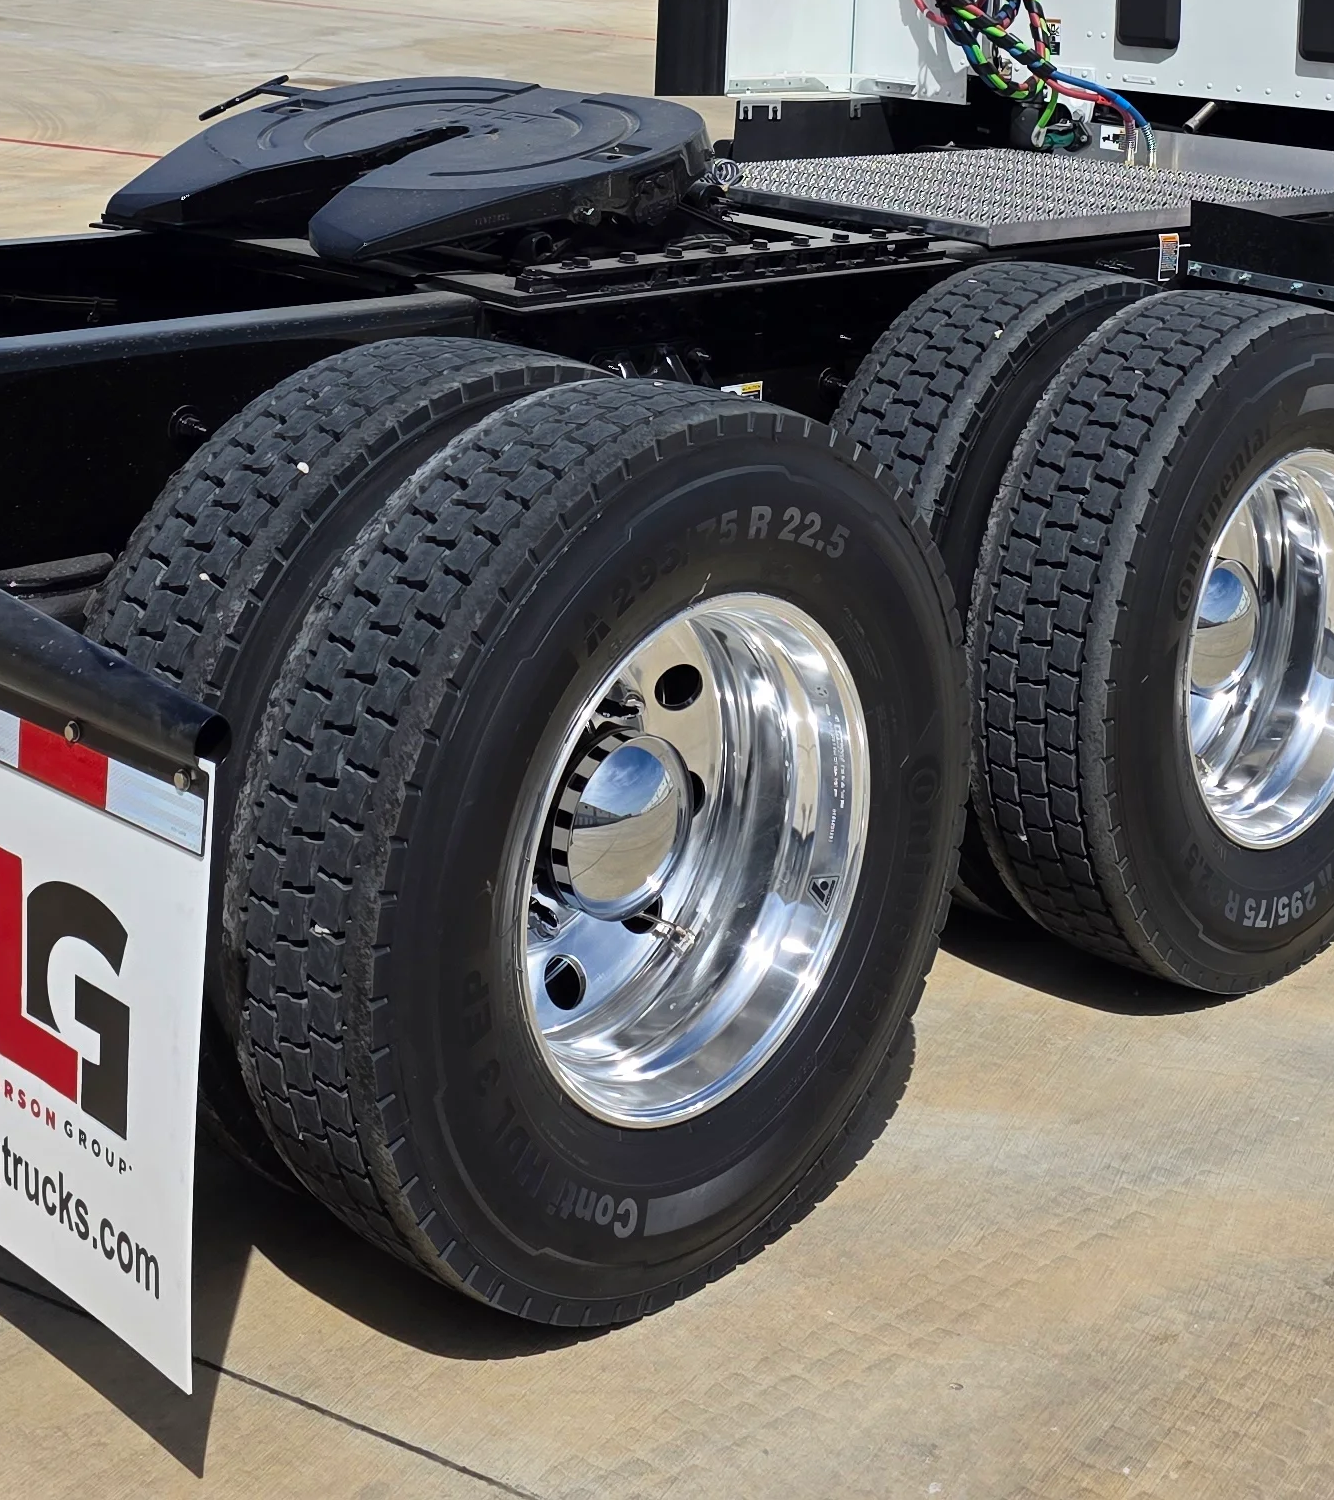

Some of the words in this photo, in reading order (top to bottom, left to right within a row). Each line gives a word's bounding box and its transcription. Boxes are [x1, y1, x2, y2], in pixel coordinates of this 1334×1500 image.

[612, 508, 738, 618] 295/75
[747, 504, 774, 541] R
[777, 505, 851, 559] 22.5
[1224, 887, 1241, 923] R
[1242, 880, 1317, 930] 295/75
[461, 968, 495, 1049] EP
[64, 1120, 128, 1175] GROUP
[545, 1178, 640, 1240] Conti
